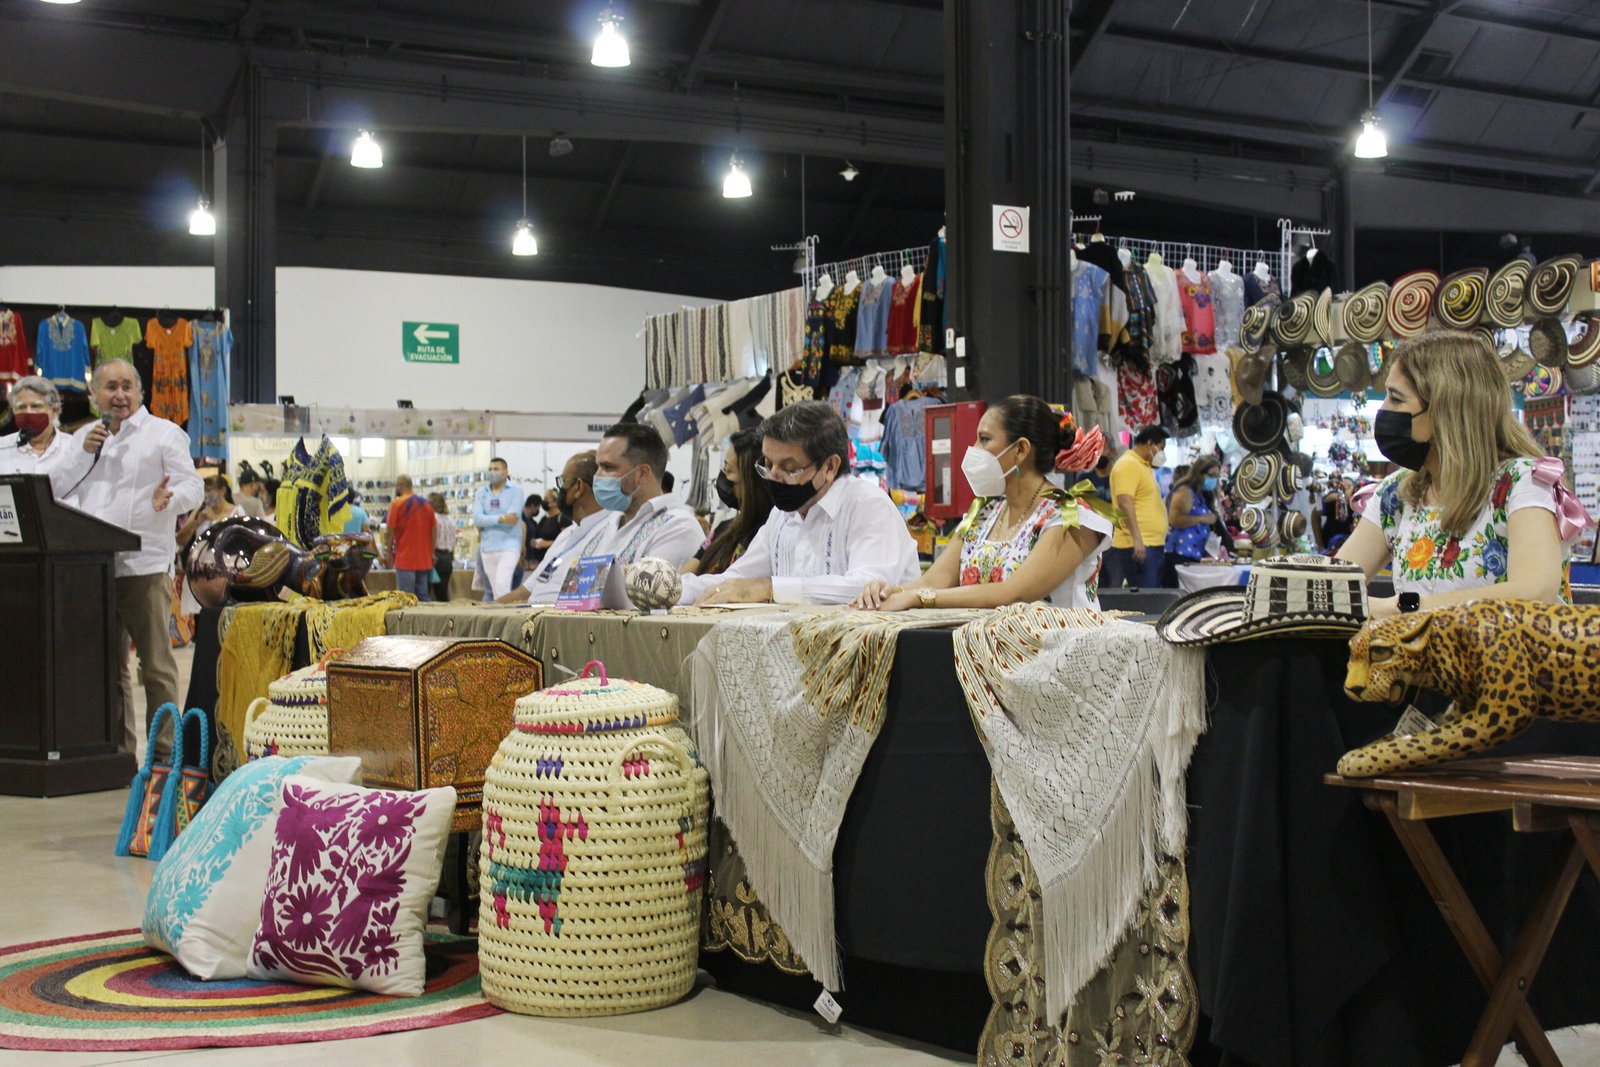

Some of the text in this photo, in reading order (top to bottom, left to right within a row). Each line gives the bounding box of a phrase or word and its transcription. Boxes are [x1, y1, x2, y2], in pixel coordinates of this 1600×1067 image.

[417, 345, 445, 354] RUTA DE
[410, 352, 453, 362] EVACUACIÓN
